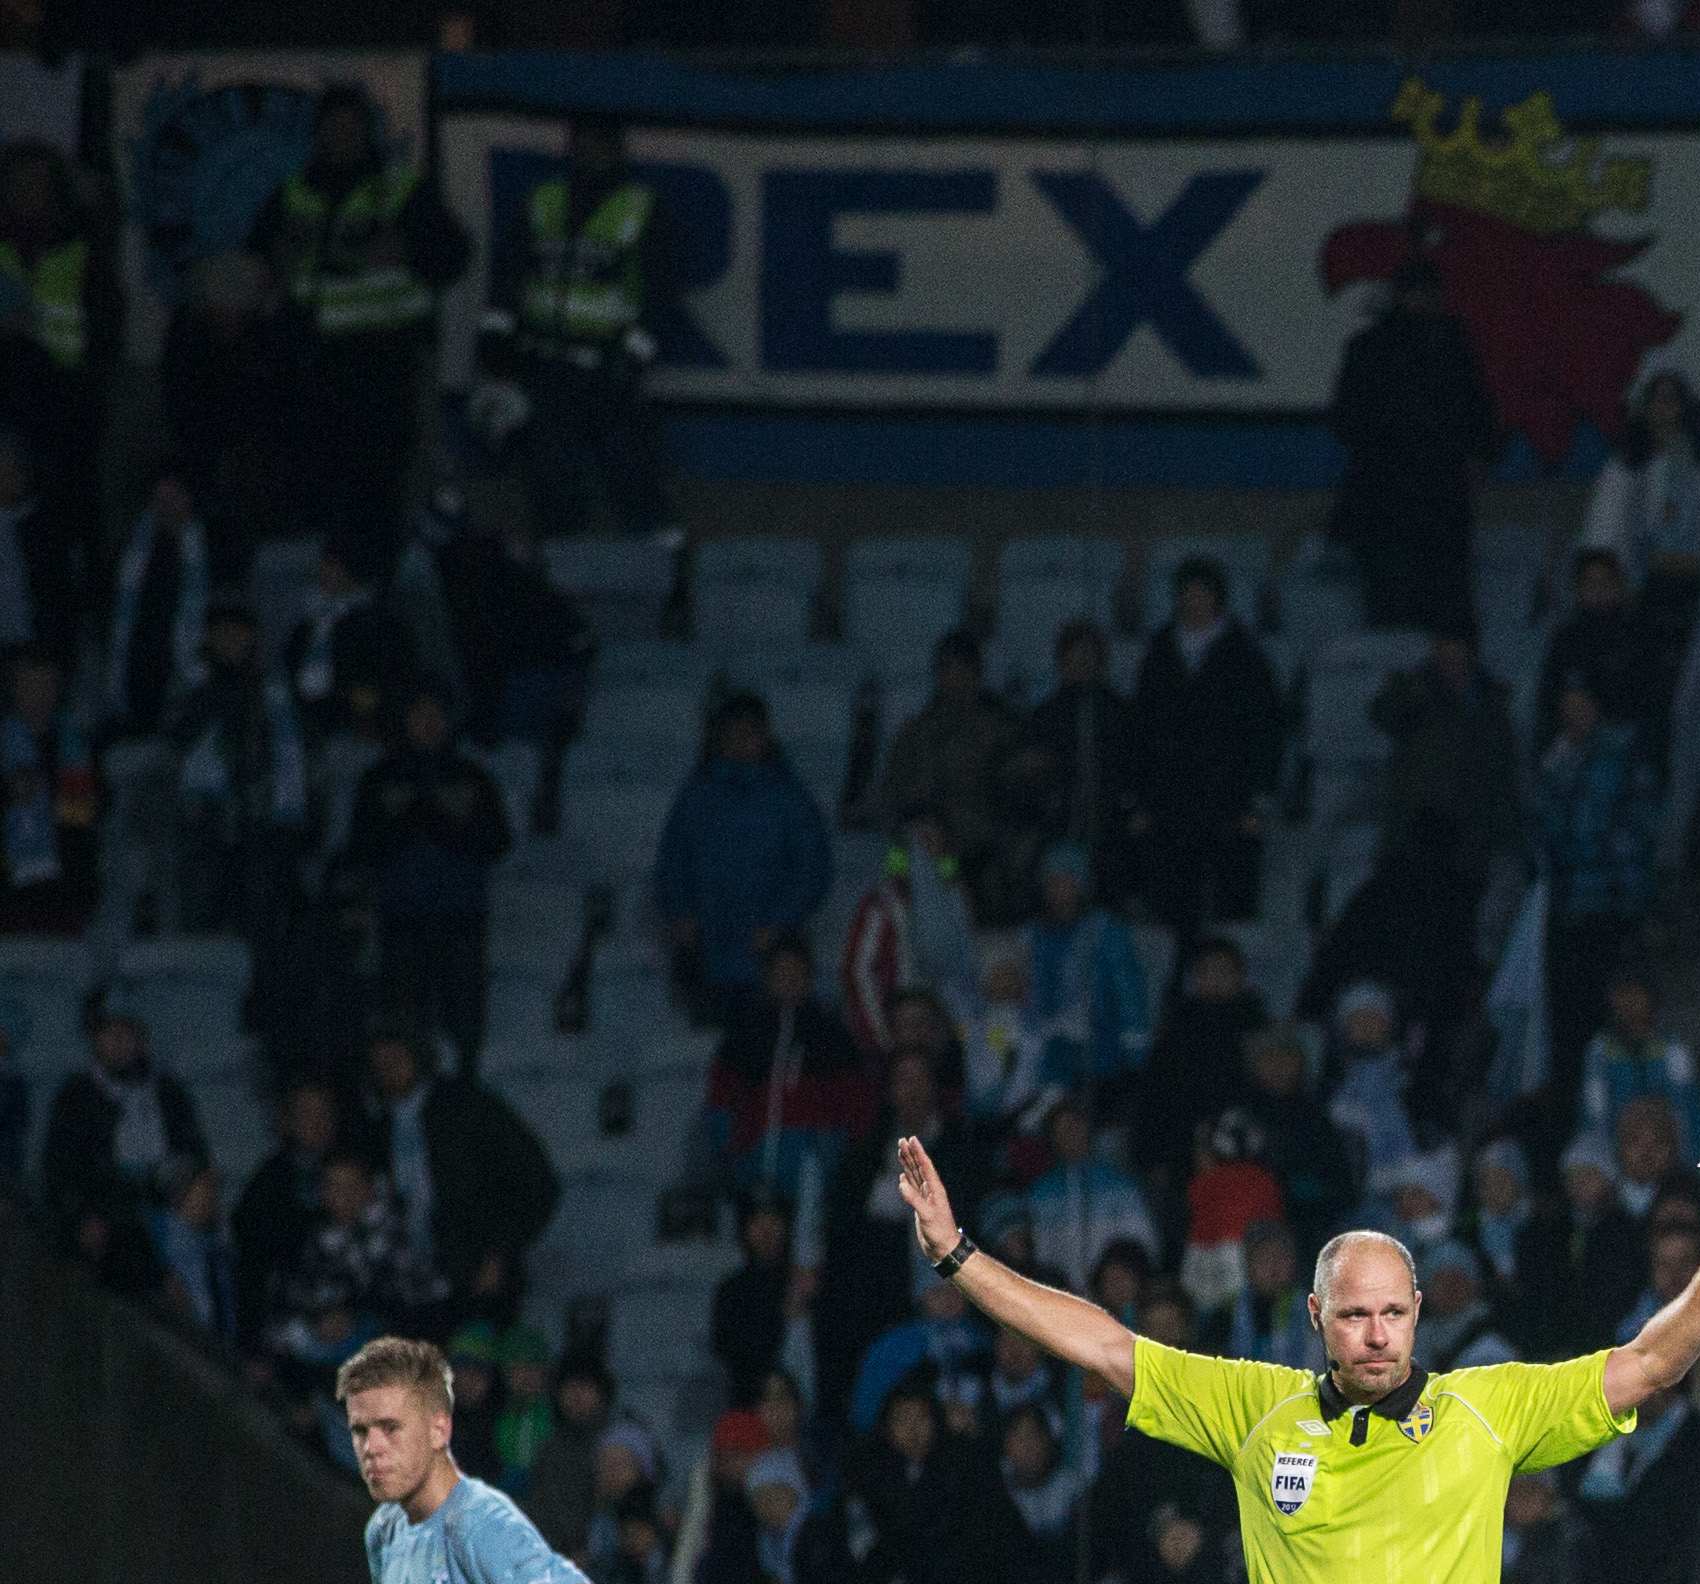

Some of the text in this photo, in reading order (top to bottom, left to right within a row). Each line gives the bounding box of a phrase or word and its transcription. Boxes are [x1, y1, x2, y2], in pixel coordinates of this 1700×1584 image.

[490, 148, 1274, 376] REX
[1277, 1456, 1315, 1467] REFEREE
[1275, 1475, 1306, 1491] FIFA
